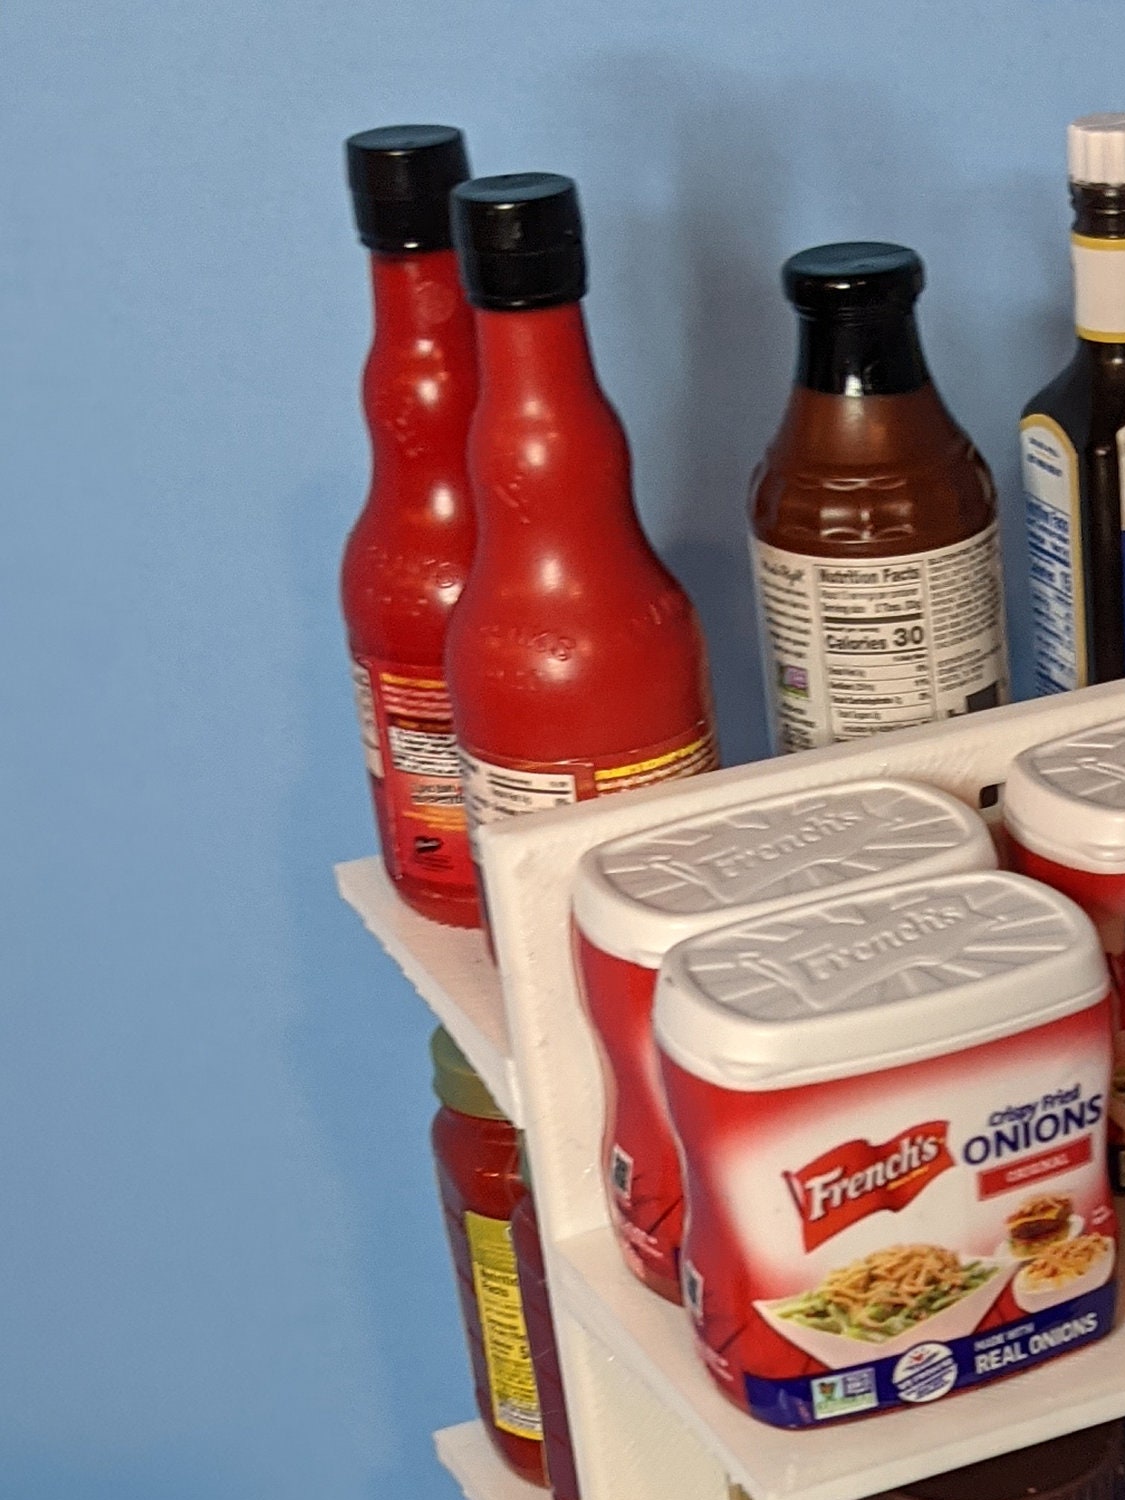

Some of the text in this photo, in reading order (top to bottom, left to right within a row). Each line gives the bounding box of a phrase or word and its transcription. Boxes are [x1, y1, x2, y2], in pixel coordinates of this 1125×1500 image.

[892, 626, 924, 647] 30
[963, 1094, 1103, 1166] ONIONS
[988, 1101, 1039, 1128] Crispy
[805, 1134, 940, 1222] French's
[974, 1342, 1028, 1374] REAL
[1028, 1312, 1098, 1355] ONIONS
